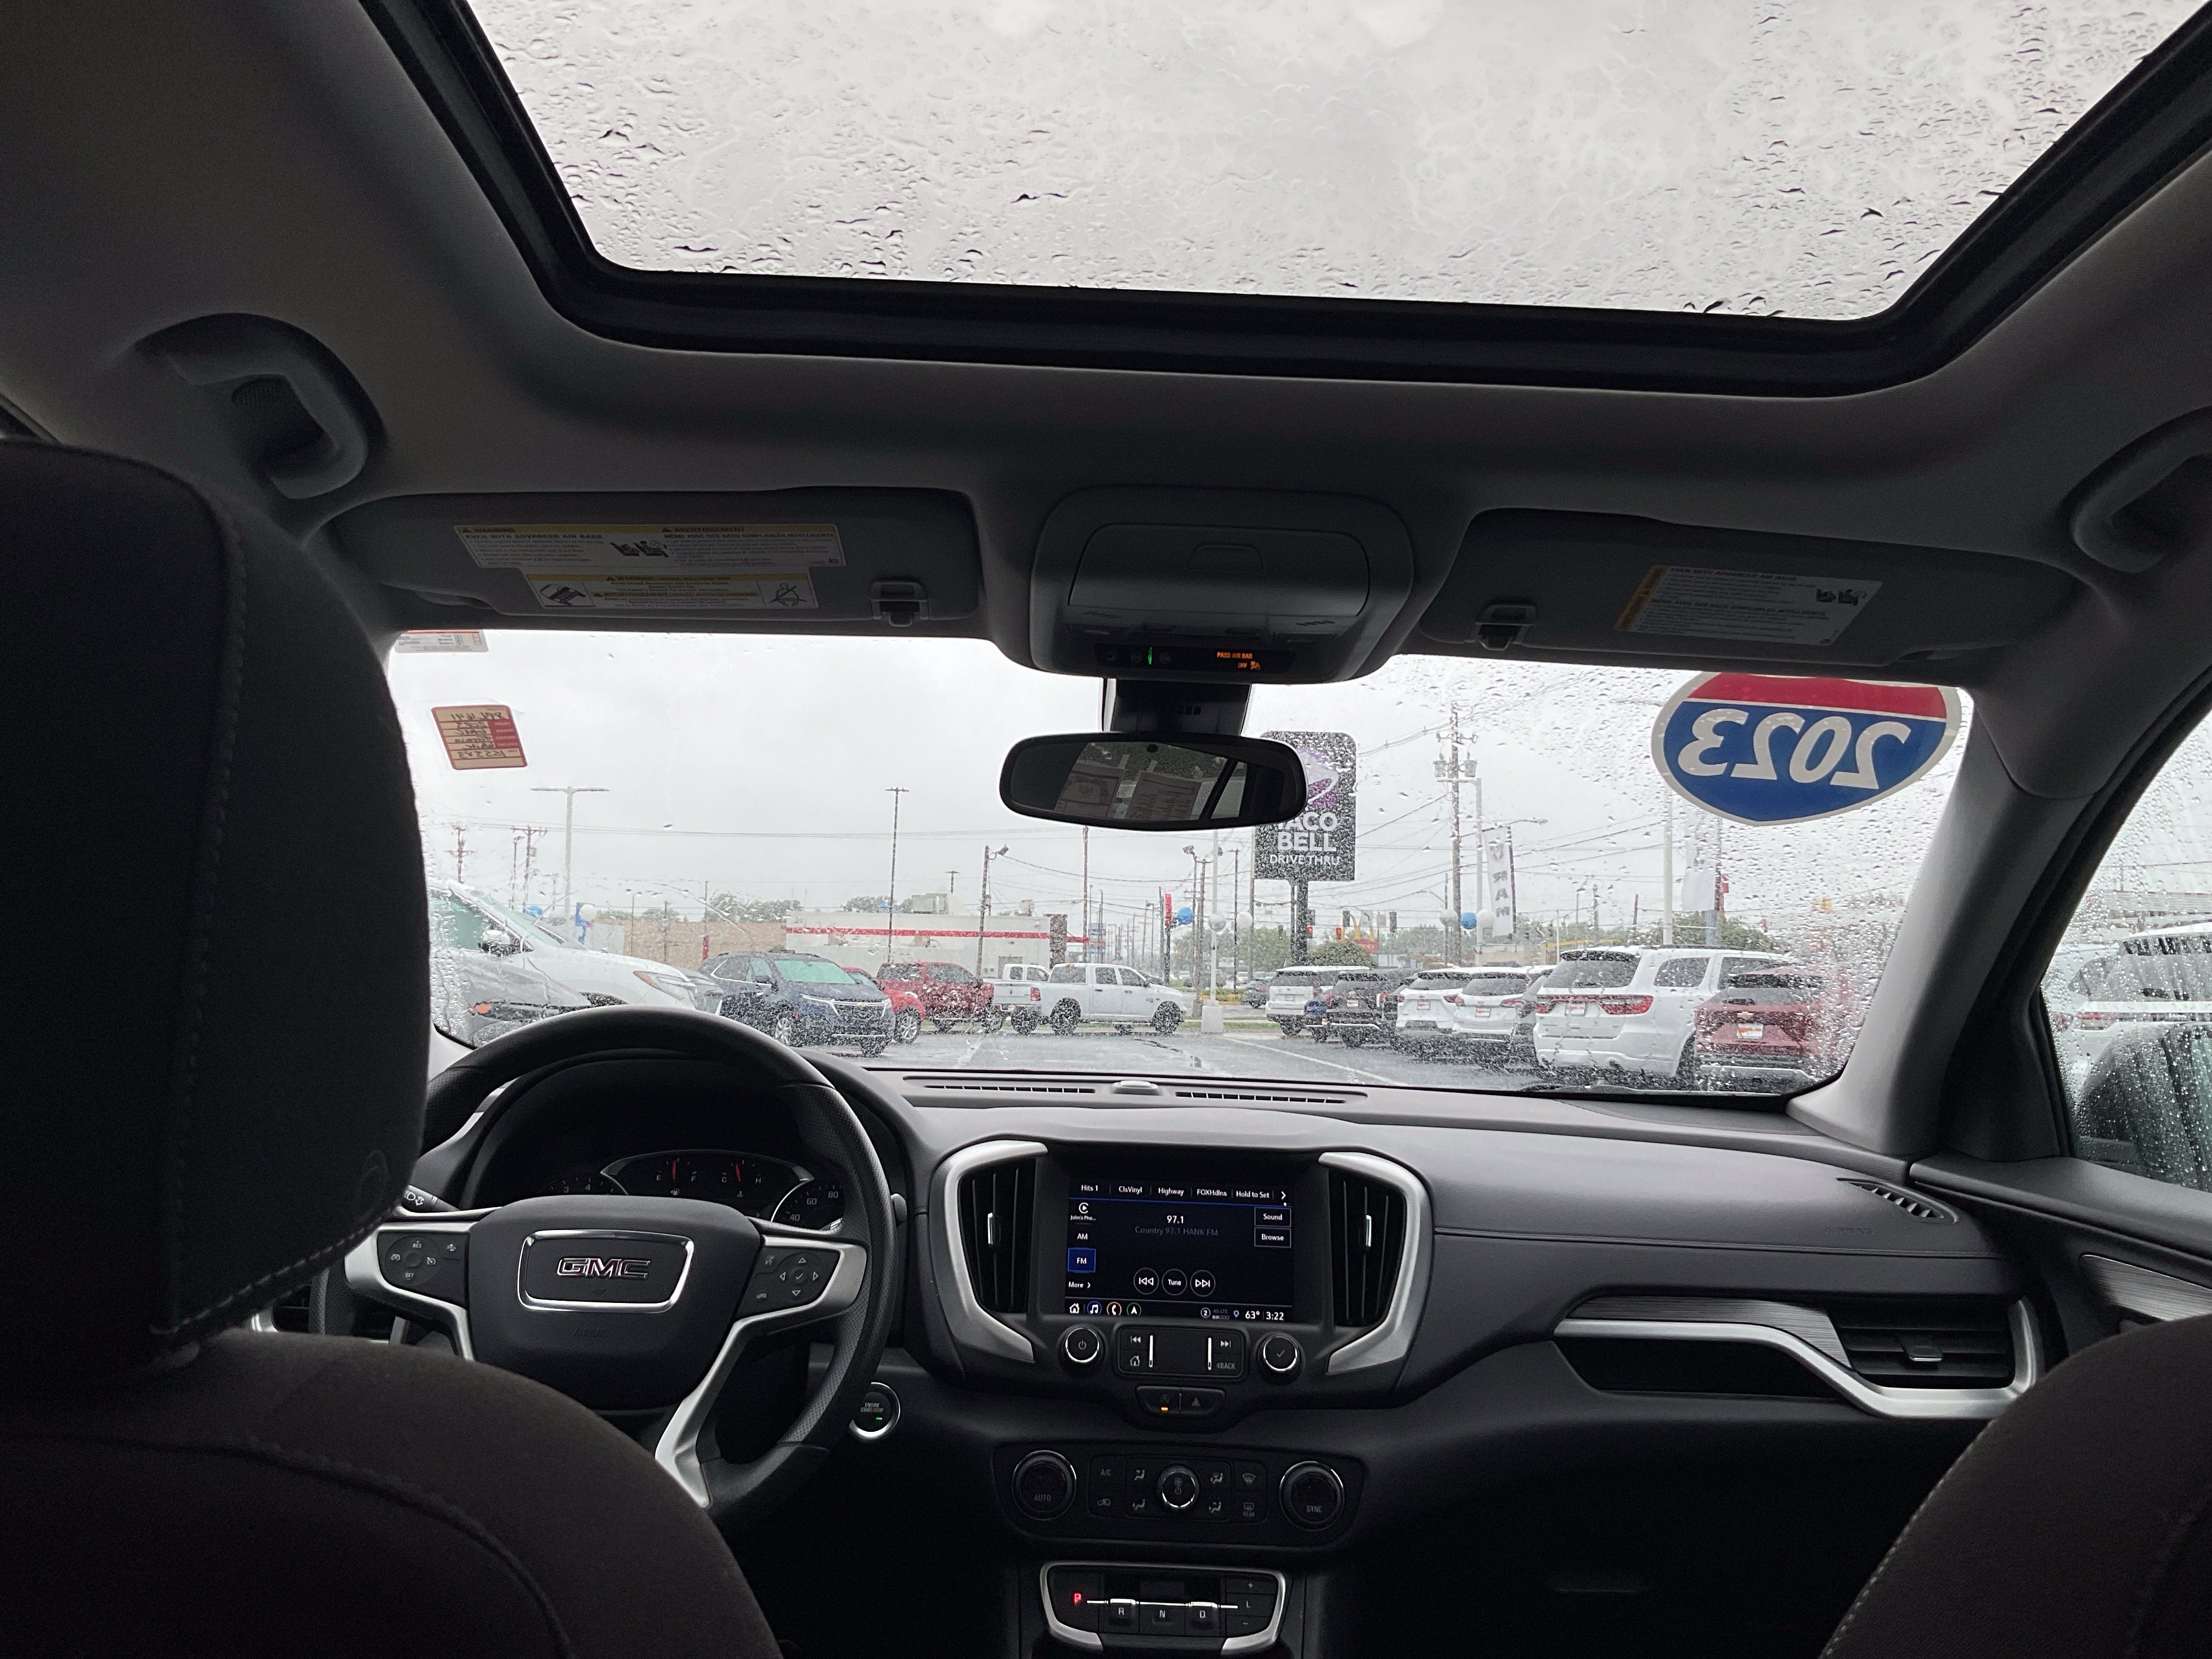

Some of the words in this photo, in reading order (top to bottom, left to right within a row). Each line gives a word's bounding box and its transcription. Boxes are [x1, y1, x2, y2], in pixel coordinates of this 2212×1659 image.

[1277, 831, 1337, 852] BELL
[1269, 855, 1305, 864] DRIVE
[1308, 856, 1340, 865] THRU
[1119, 1186, 1142, 1194] ClsVinyl
[1158, 1187, 1184, 1197] Highway
[1167, 1215, 1184, 1224] 97.1
[1263, 1213, 1283, 1221] Sound
[1135, 1226, 1164, 1236] Country
[1165, 1227, 1182, 1235] 97.1
[1183, 1227, 1205, 1236] HANK
[1206, 1228, 1218, 1237] FM
[1261, 1233, 1284, 1242] Browse
[557, 1257, 651, 1280] GMC
[1245, 1310, 1260, 1319] 63°
[1266, 1311, 1284, 1321] 3:22
[1221, 1362, 1237, 1370] BACK
[1034, 1494, 1051, 1502] AUTO
[1306, 1505, 1323, 1513] SYNC
[1074, 1593, 1081, 1602] P
[1118, 1607, 1125, 1615] R
[1159, 1609, 1166, 1618] N
